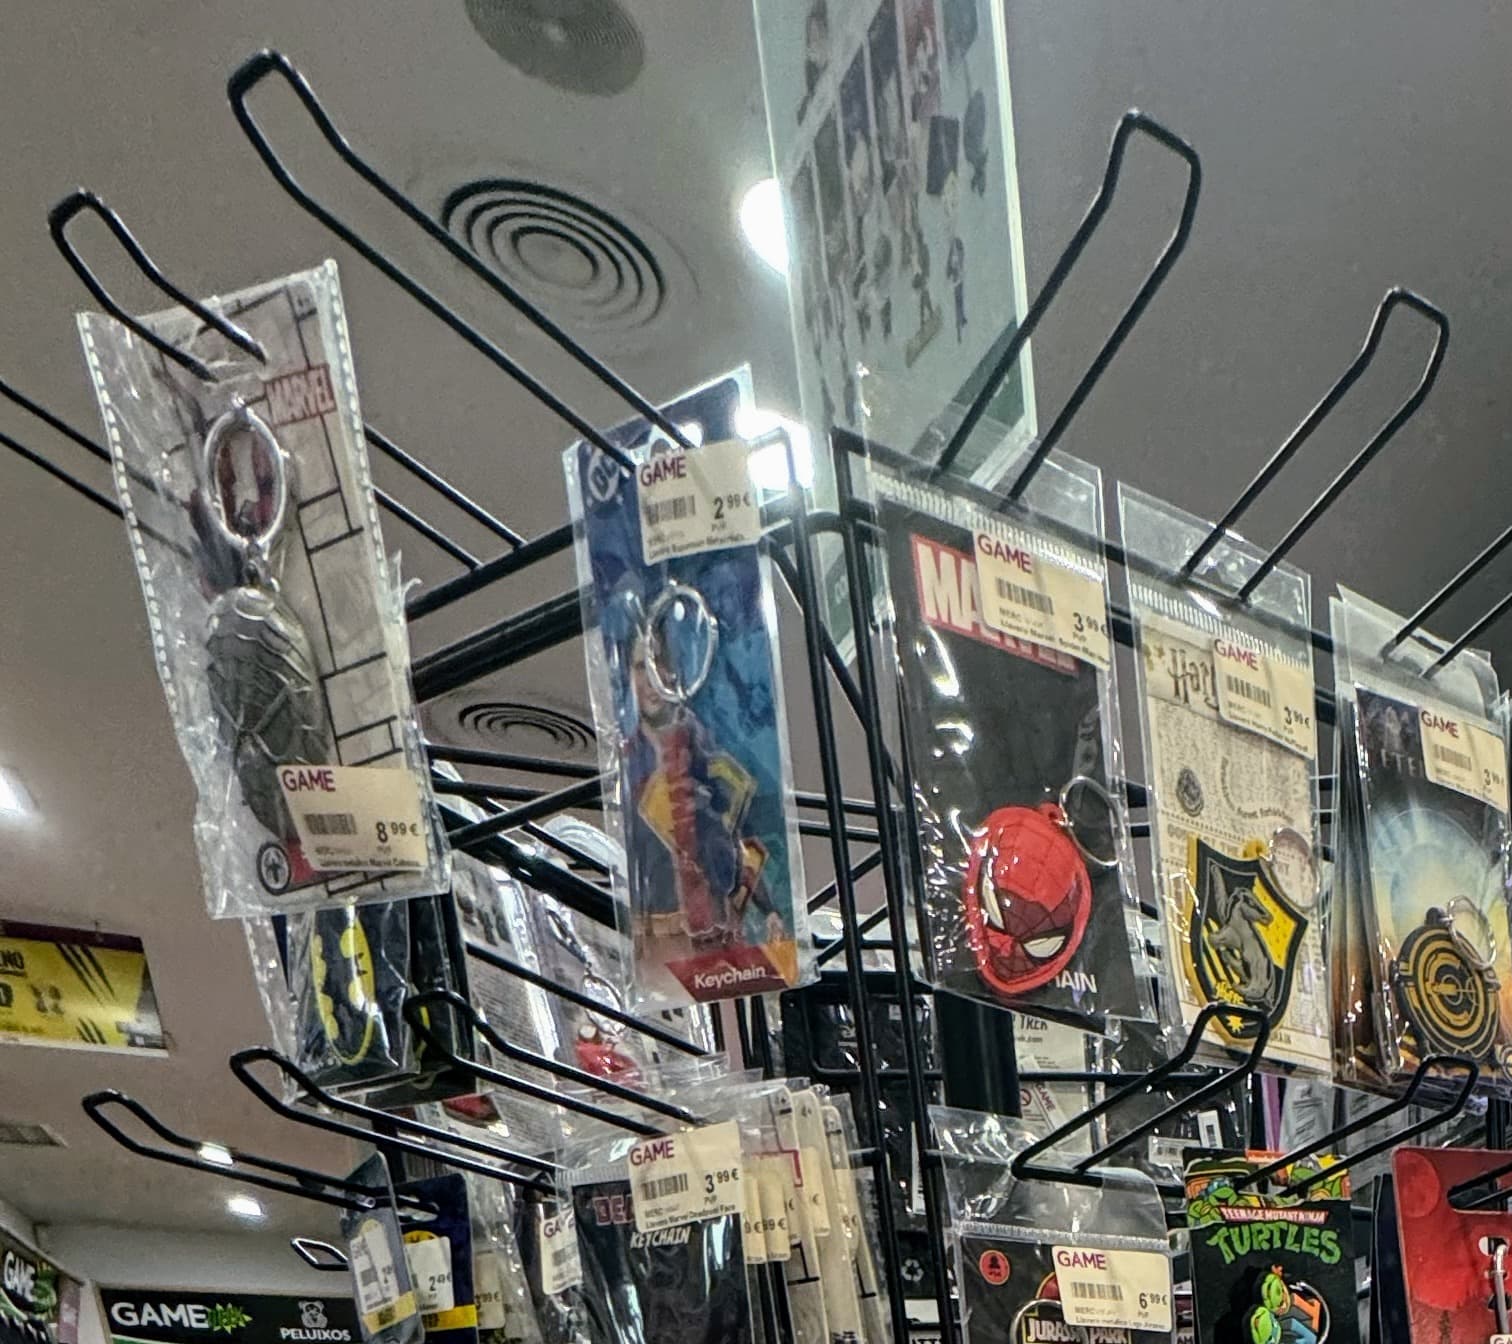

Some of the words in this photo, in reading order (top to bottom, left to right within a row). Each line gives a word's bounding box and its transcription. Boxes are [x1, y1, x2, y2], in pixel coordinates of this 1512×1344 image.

[640, 458, 687, 486] GAME
[977, 534, 1032, 574] GAME
[1214, 639, 1259, 671] GAME
[1421, 710, 1459, 739] GAME
[281, 768, 335, 793] GAME
[694, 962, 767, 989] Keychain
[630, 1140, 674, 1166] GAME
[1223, 1208, 1264, 1222] TEENAGE
[1265, 1210, 1297, 1222] MUTANT
[1297, 1211, 1327, 1223] NINJA
[630, 1228, 689, 1249] KEYCHAIN
[1207, 1220, 1341, 1264] TURTLES
[1057, 1249, 1106, 1270] GAME
[4, 1252, 36, 1297] GAME
[111, 1302, 208, 1329] GAME
[281, 1326, 350, 1342] PELUIXOS
